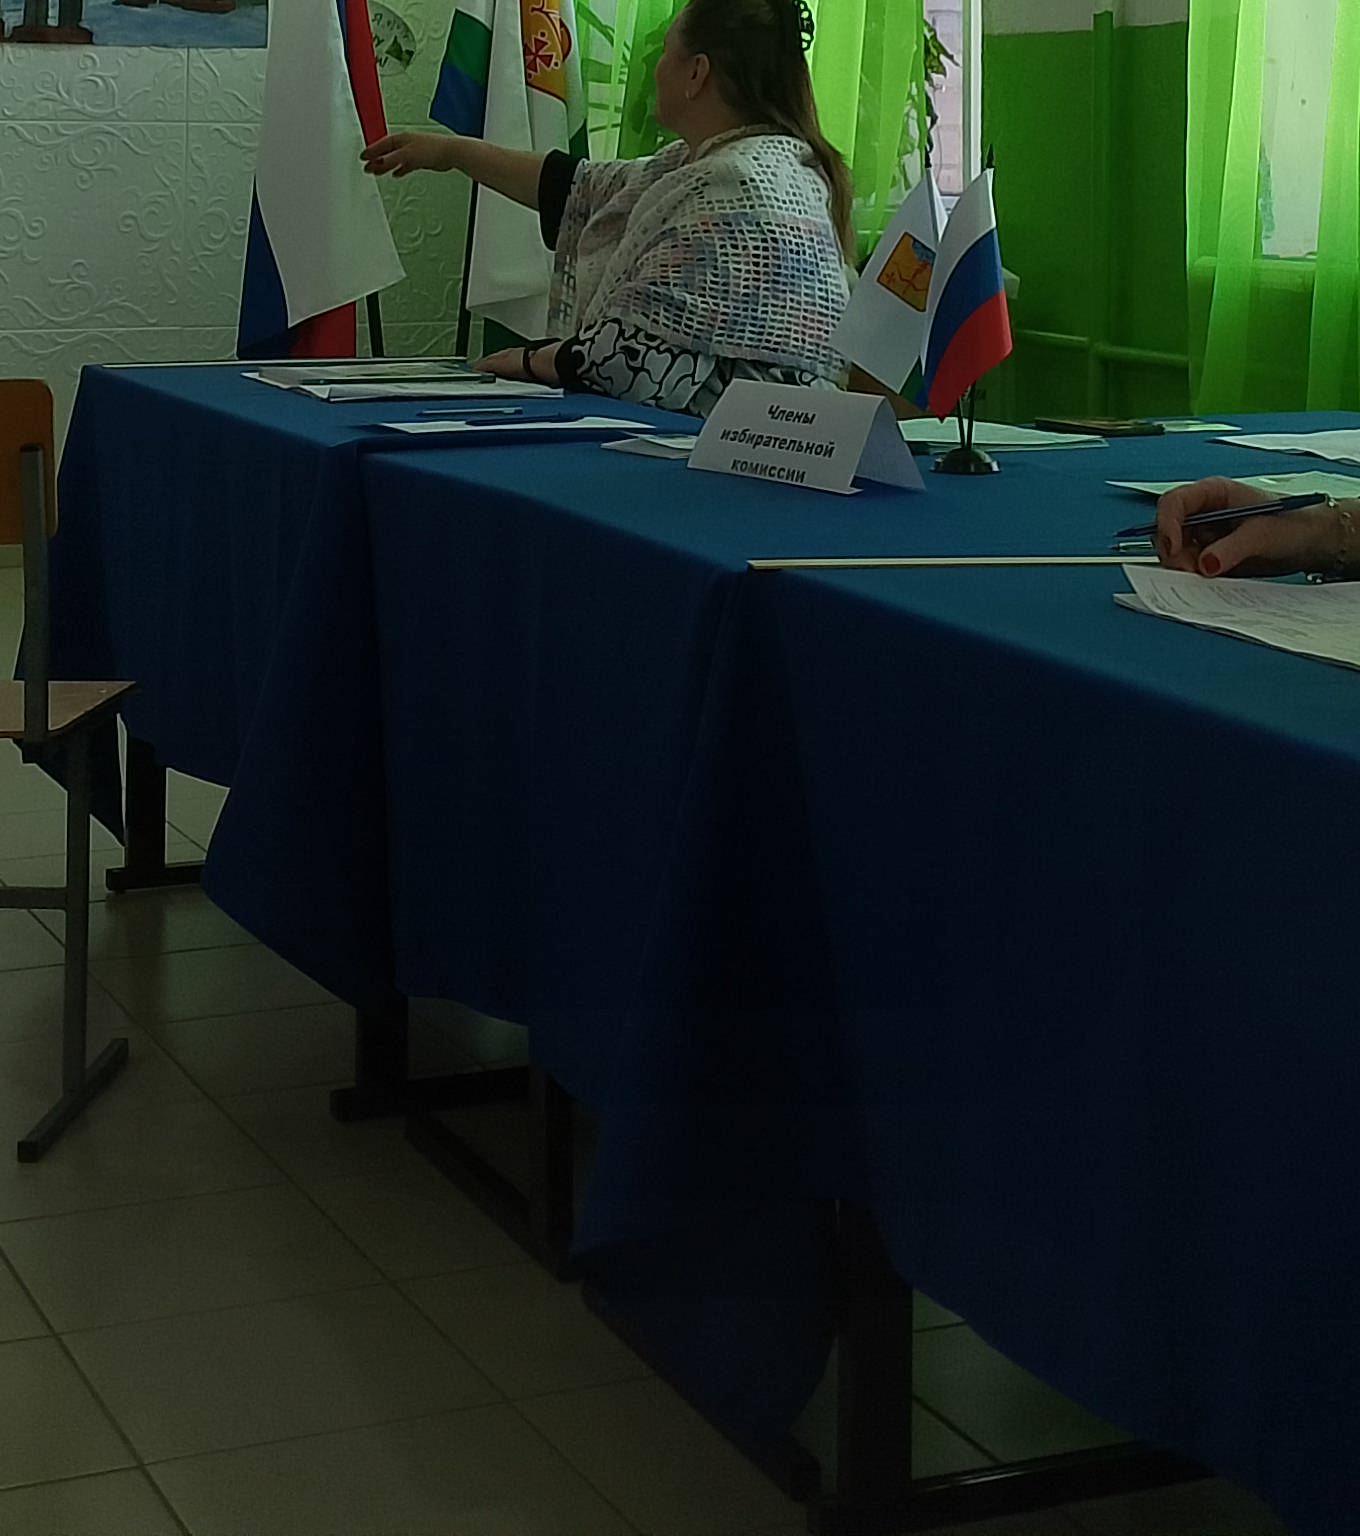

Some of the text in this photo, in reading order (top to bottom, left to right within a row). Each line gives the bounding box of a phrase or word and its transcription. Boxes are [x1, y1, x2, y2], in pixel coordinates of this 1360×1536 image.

[767, 404, 816, 425] Члены
[720, 428, 836, 459] избирательной
[730, 458, 807, 484] комиссии
